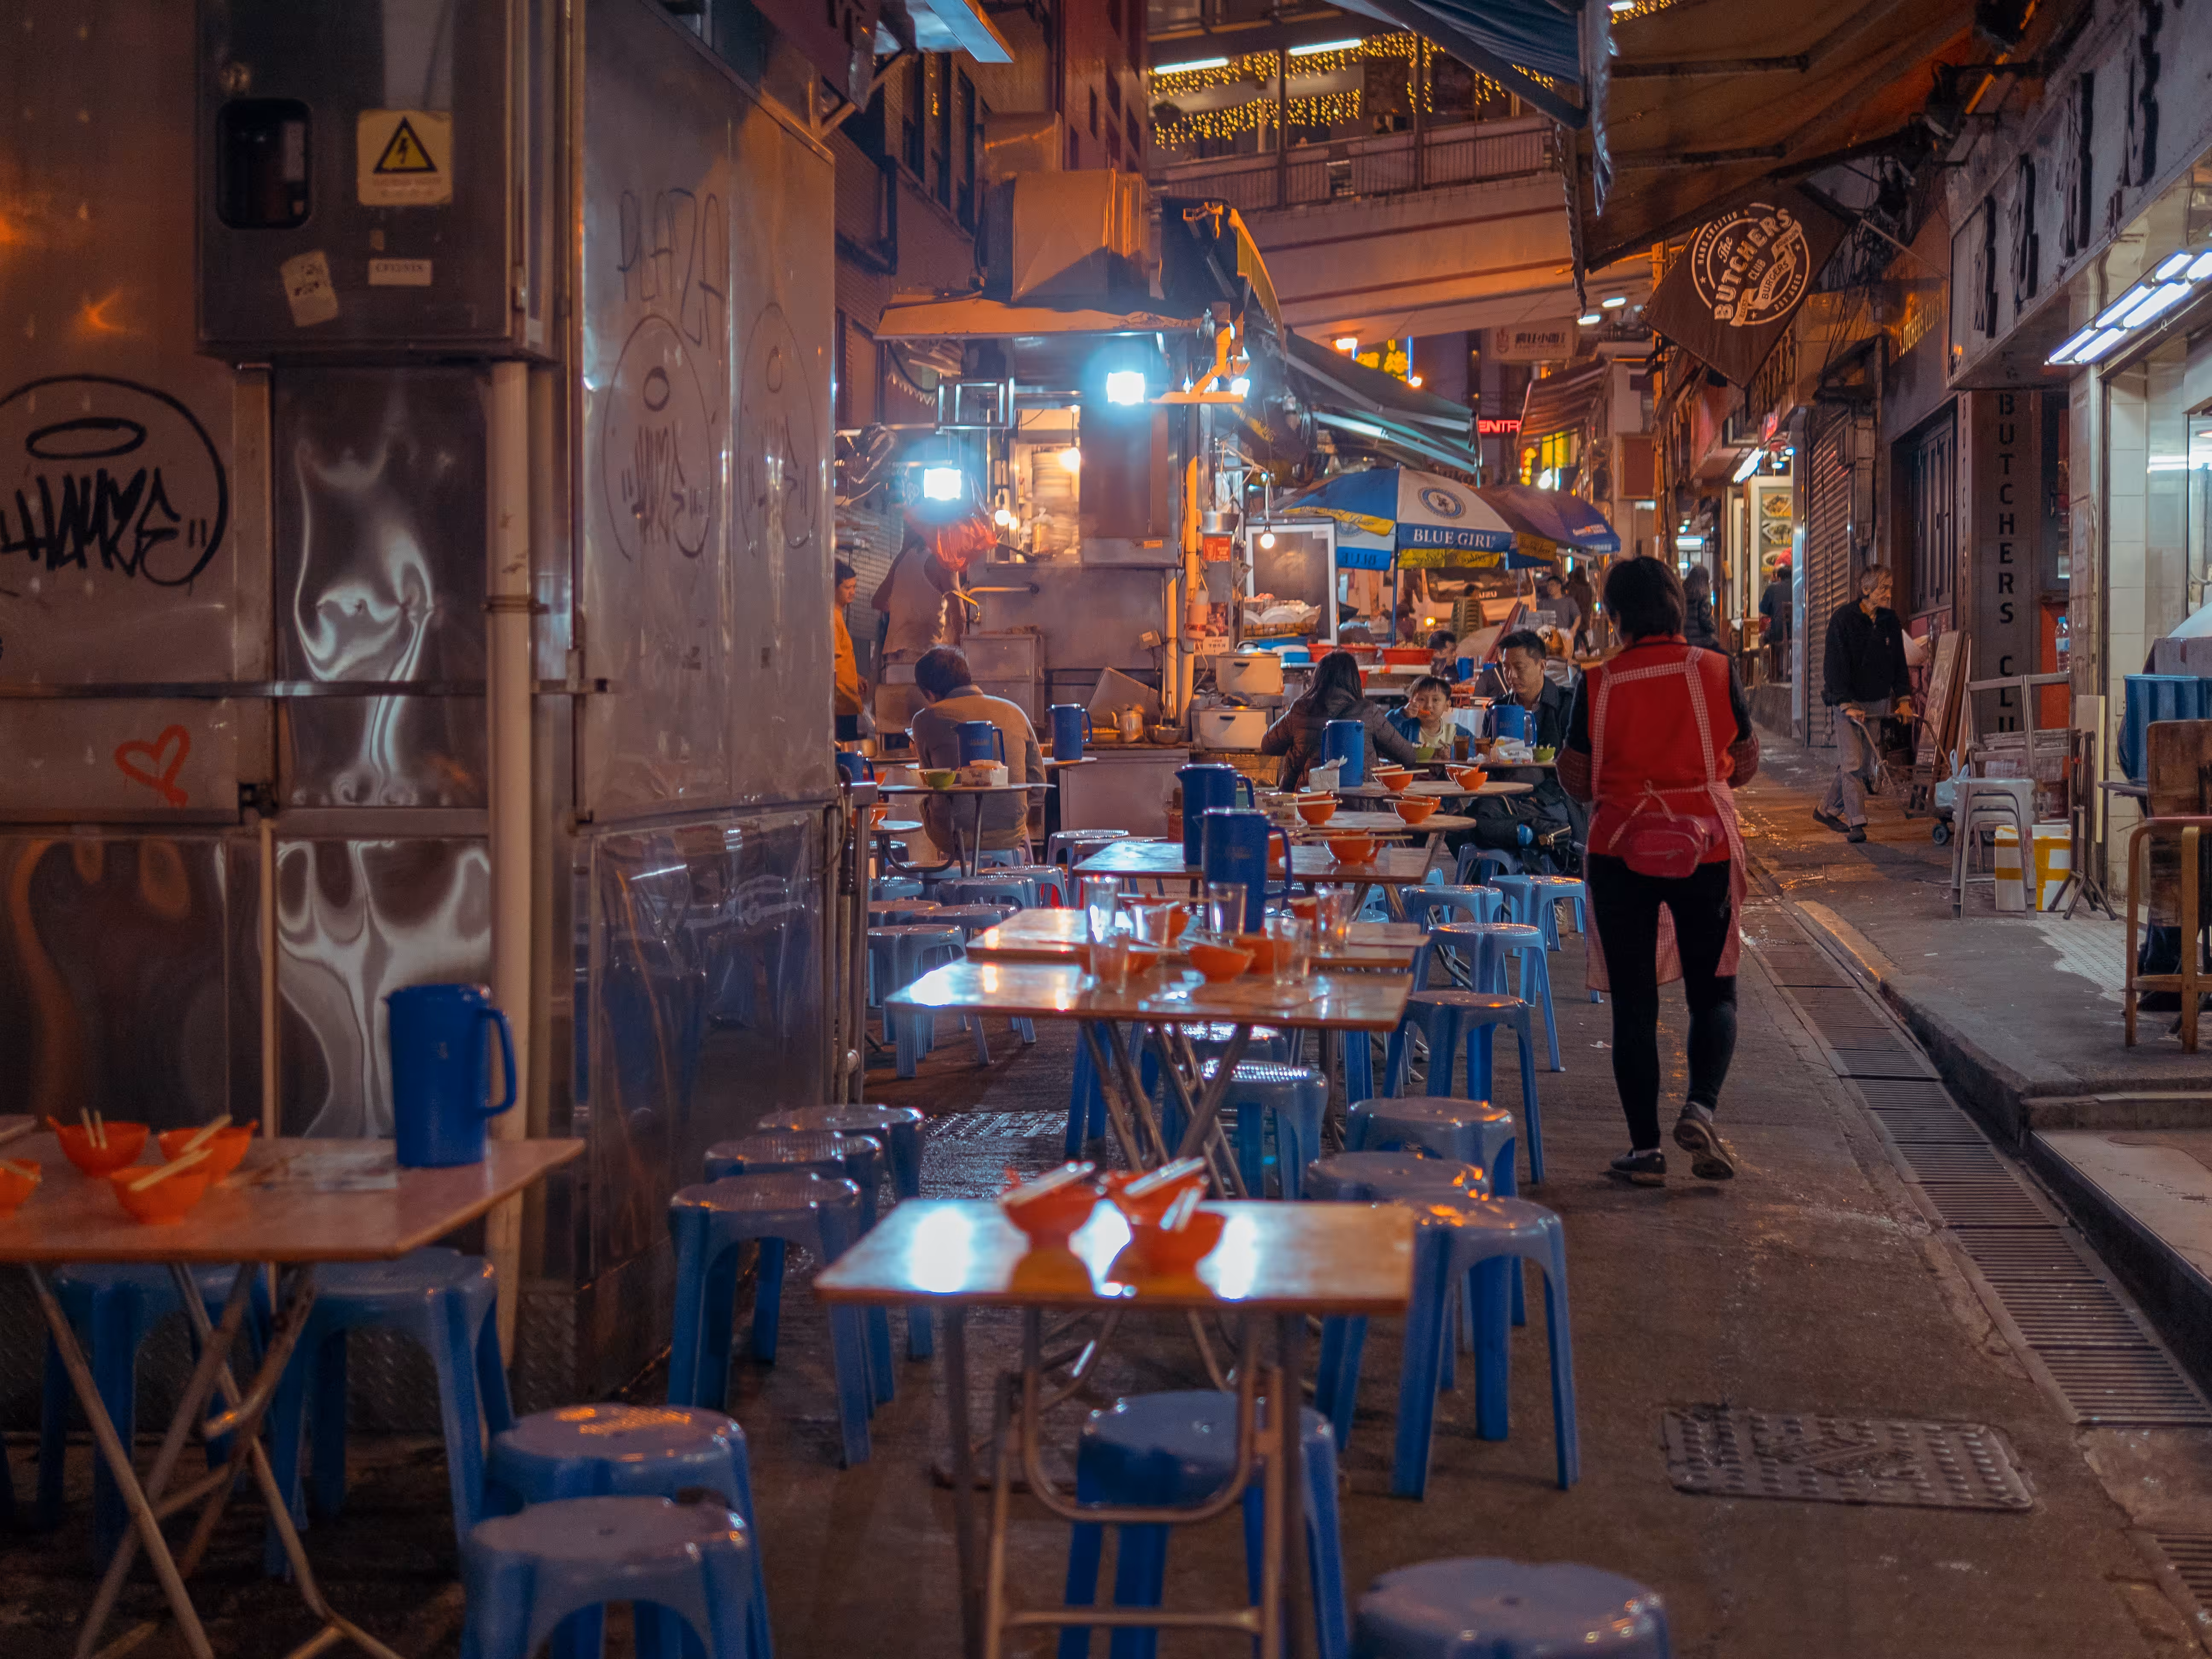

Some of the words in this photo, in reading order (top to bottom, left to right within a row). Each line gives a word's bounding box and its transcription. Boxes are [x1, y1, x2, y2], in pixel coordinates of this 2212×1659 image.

[1706, 212, 1738, 240] CRAFTED
[1717, 236, 1733, 263] The
[1714, 208, 1792, 320] BUTCHERS
[1748, 259, 1766, 281] CLUB
[1762, 260, 1789, 300] BURGERS
[1998, 393, 2015, 624] BUTCHERS
[1413, 528, 1454, 544] BLUE
[1458, 532, 1493, 548] GIRL
